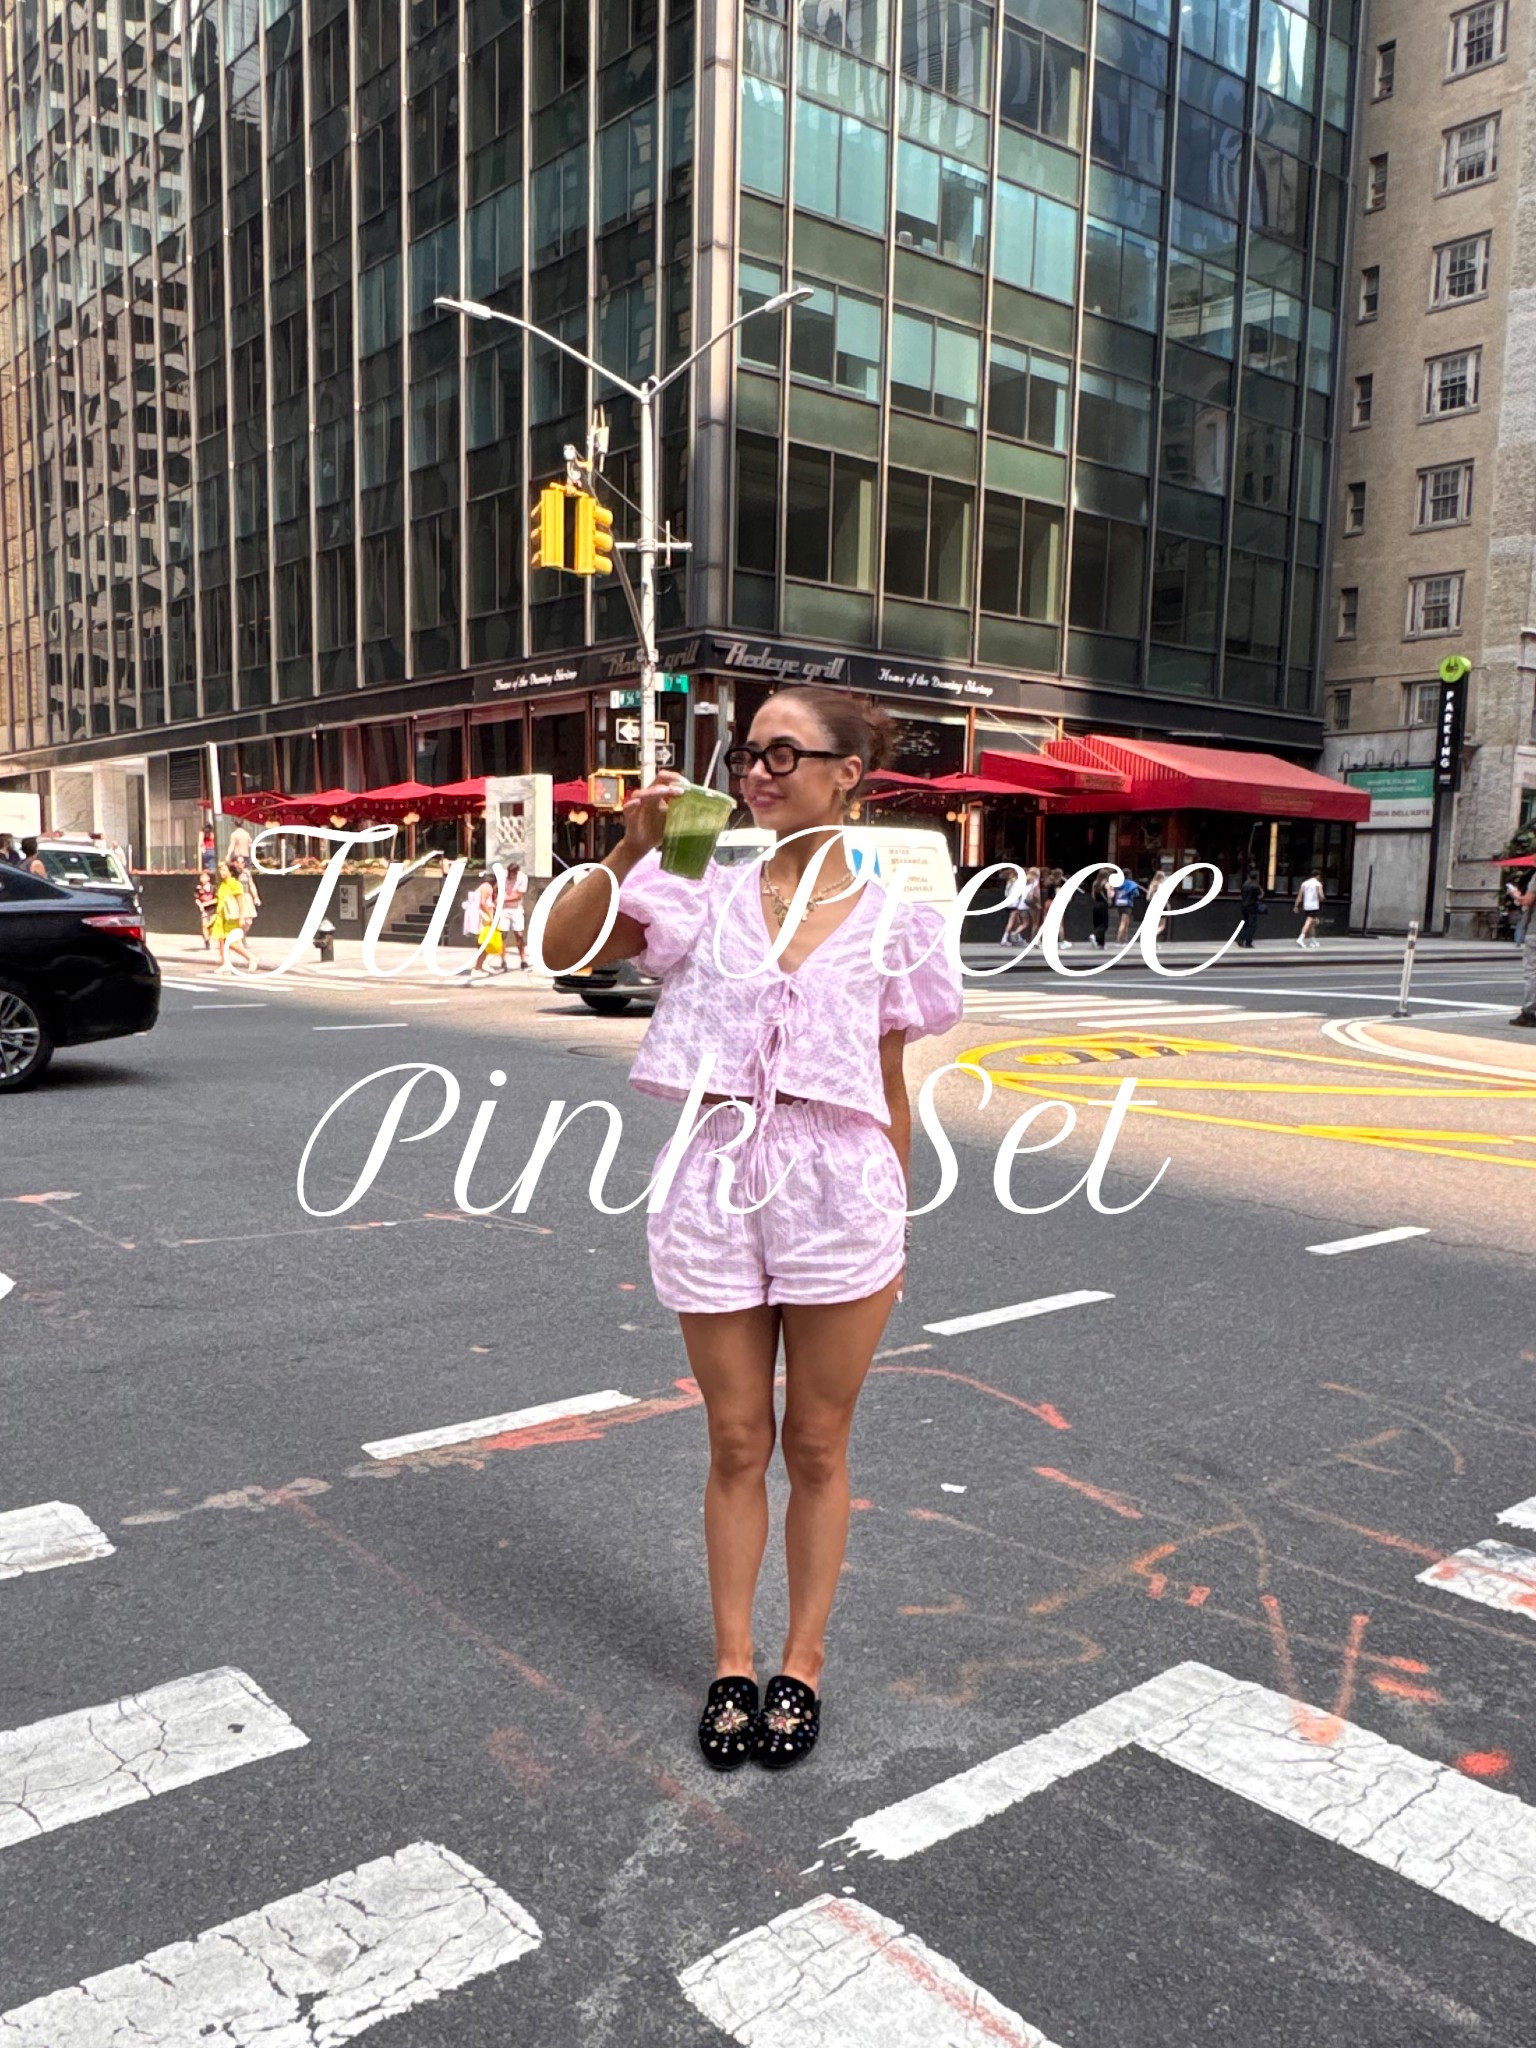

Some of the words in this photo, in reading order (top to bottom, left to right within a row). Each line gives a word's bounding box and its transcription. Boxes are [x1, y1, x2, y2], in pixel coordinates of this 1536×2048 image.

[714, 640, 801, 680] Redeye
[802, 657, 846, 682] grill
[878, 668, 906, 683] Home
[906, 673, 917, 688] of
[916, 673, 929, 686] the
[964, 680, 994, 697] Shrimp
[1440, 690, 1455, 768] PARKING
